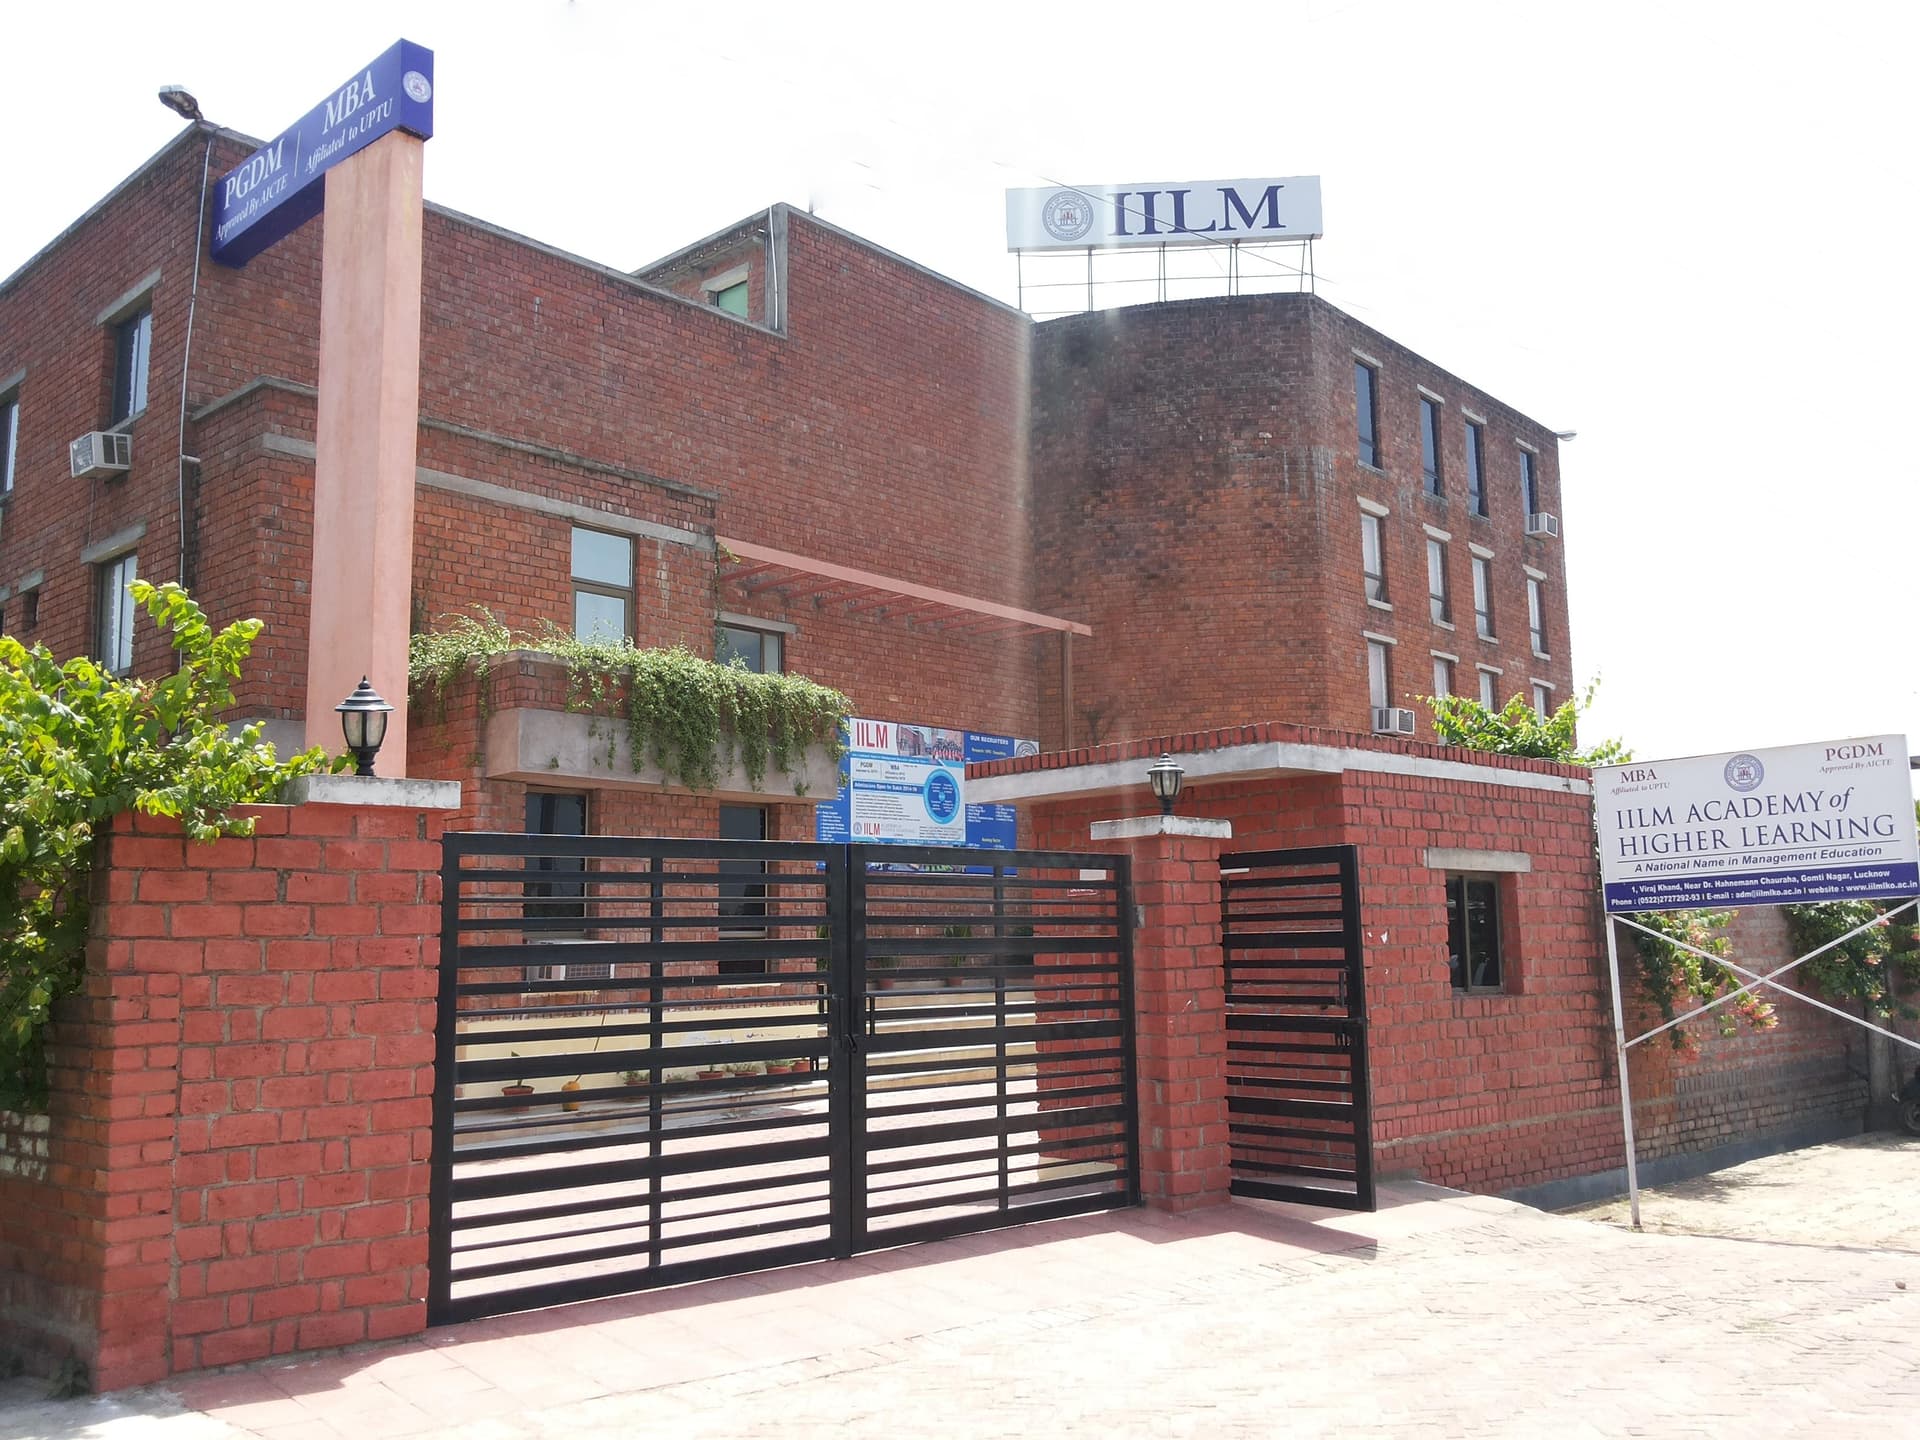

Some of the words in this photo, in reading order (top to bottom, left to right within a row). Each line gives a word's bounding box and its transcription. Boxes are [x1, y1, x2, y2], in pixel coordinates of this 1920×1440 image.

[322, 70, 376, 135] MBA
[305, 128, 346, 174] Affiliated
[348, 126, 358, 141] to
[360, 98, 393, 133] UPTU
[224, 138, 285, 210] PGDM
[215, 204, 249, 241] Approved
[249, 197, 260, 217] By
[259, 173, 289, 204] AICTE
[1107, 184, 1287, 238] IILM
[856, 721, 888, 749] IILM
[1825, 743, 1884, 761] PGDM
[1620, 768, 1657, 783] MBA
[1819, 762, 1854, 774] Approved
[1855, 761, 1865, 769] By
[1866, 759, 1892, 768] AICTE
[1610, 784, 1639, 796] Affiliated
[1641, 783, 1648, 791] to
[1649, 782, 1670, 790] UPTU
[1616, 805, 1676, 829] IILM
[1686, 790, 1825, 823] ACADEMY
[1829, 786, 1855, 812] of
[863, 823, 880, 836] IILM
[1618, 829, 1732, 856] HIGHER
[1741, 814, 1895, 847] LEARNING
[1634, 863, 1643, 872] A
[1645, 859, 1690, 872] National
[1693, 857, 1725, 869] Name
[1728, 856, 1739, 866] in
[1742, 851, 1817, 865] Management
[1820, 847, 1883, 860] Education
[1631, 886, 1639, 894] 1,
[1640, 884, 1657, 893] Viraj
[1657, 882, 1683, 892] Khand,
[1684, 882, 1702, 890] Near
[1703, 880, 1714, 889] Dr.
[1715, 878, 1759, 888] Hahnemann
[1760, 876, 1800, 885] Chauraha,
[1801, 873, 1825, 882] Gomti
[1826, 872, 1853, 881] Nagar,
[1854, 870, 1891, 879] Lucknow
[1706, 890, 1730, 900] E-mail
[1808, 885, 1840, 894] website
